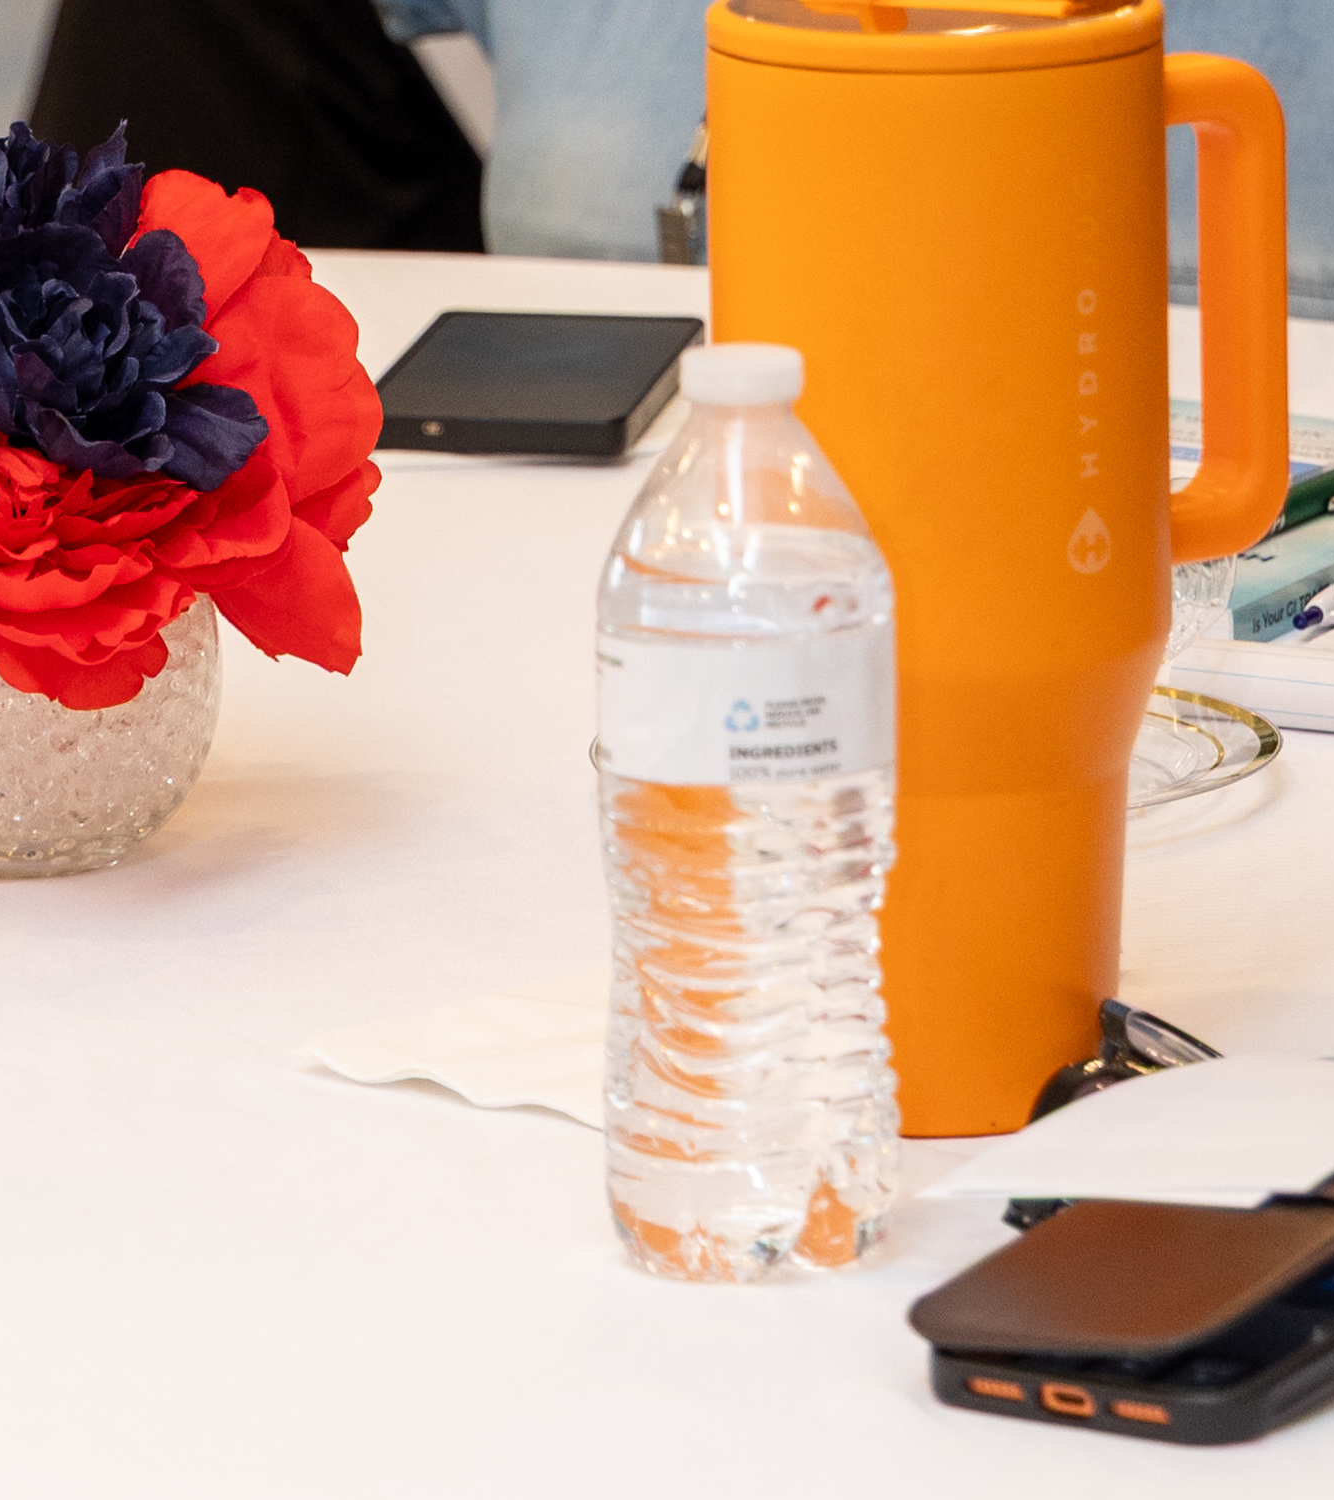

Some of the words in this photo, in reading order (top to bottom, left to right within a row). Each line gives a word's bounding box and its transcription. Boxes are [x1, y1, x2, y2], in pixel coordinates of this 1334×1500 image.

[1252, 618, 1261, 634] Is
[1262, 608, 1284, 627] Your
[730, 738, 837, 760] INGREDIENTS
